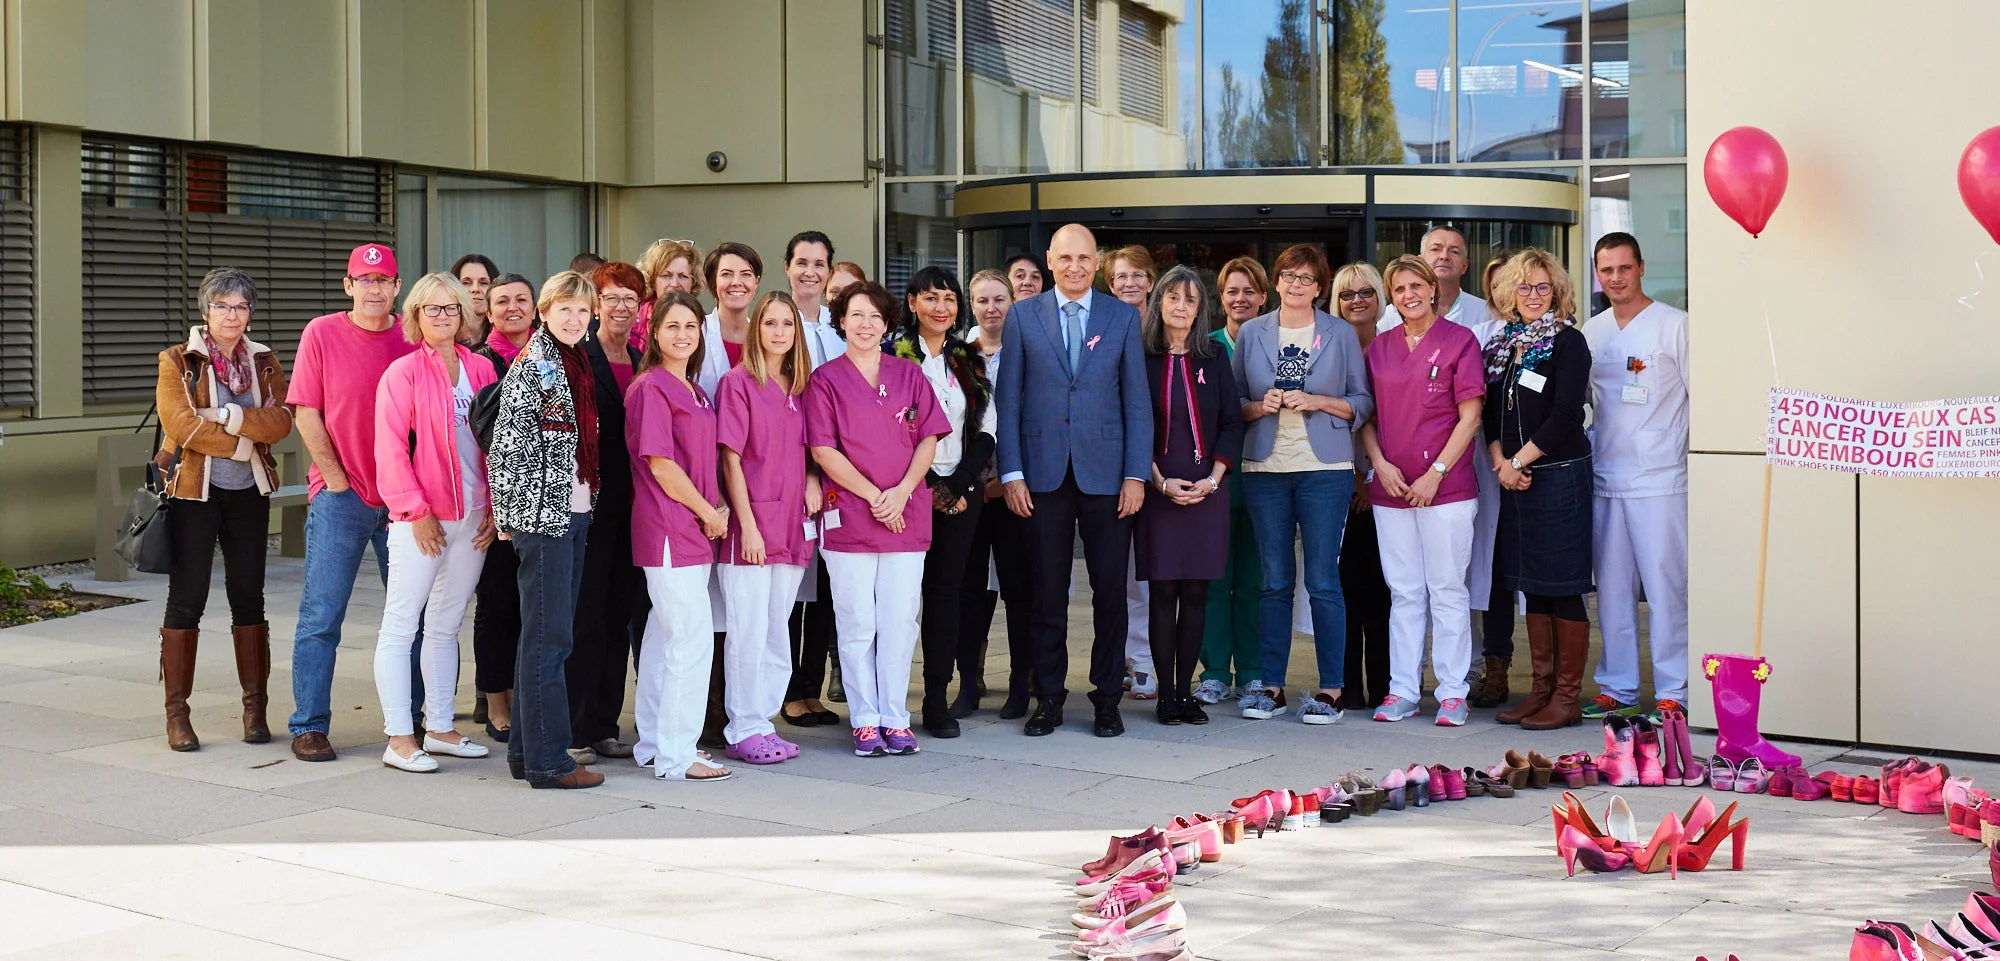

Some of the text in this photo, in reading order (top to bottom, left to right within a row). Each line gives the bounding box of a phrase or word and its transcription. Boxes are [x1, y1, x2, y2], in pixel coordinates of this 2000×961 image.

[1778, 387, 1818, 398] SOUTIEN
[1880, 400, 1941, 409] LUXEMBOURG
[1944, 396, 1990, 406] NOUVEAUX
[1778, 397, 1996, 428] 450 NOUVEAUX CAS
[1778, 418, 1962, 448] CANCER DU SEIN
[1965, 428, 1989, 437] BLEIF
[1776, 438, 1934, 468] LUXEMBOURG
[1937, 450, 1977, 459] FEMMES
[1775, 458, 1796, 467] PINK
[1798, 461, 1828, 470] SHOES
[1830, 464, 1868, 474] FEMMES
[1871, 469, 1889, 477] 450
